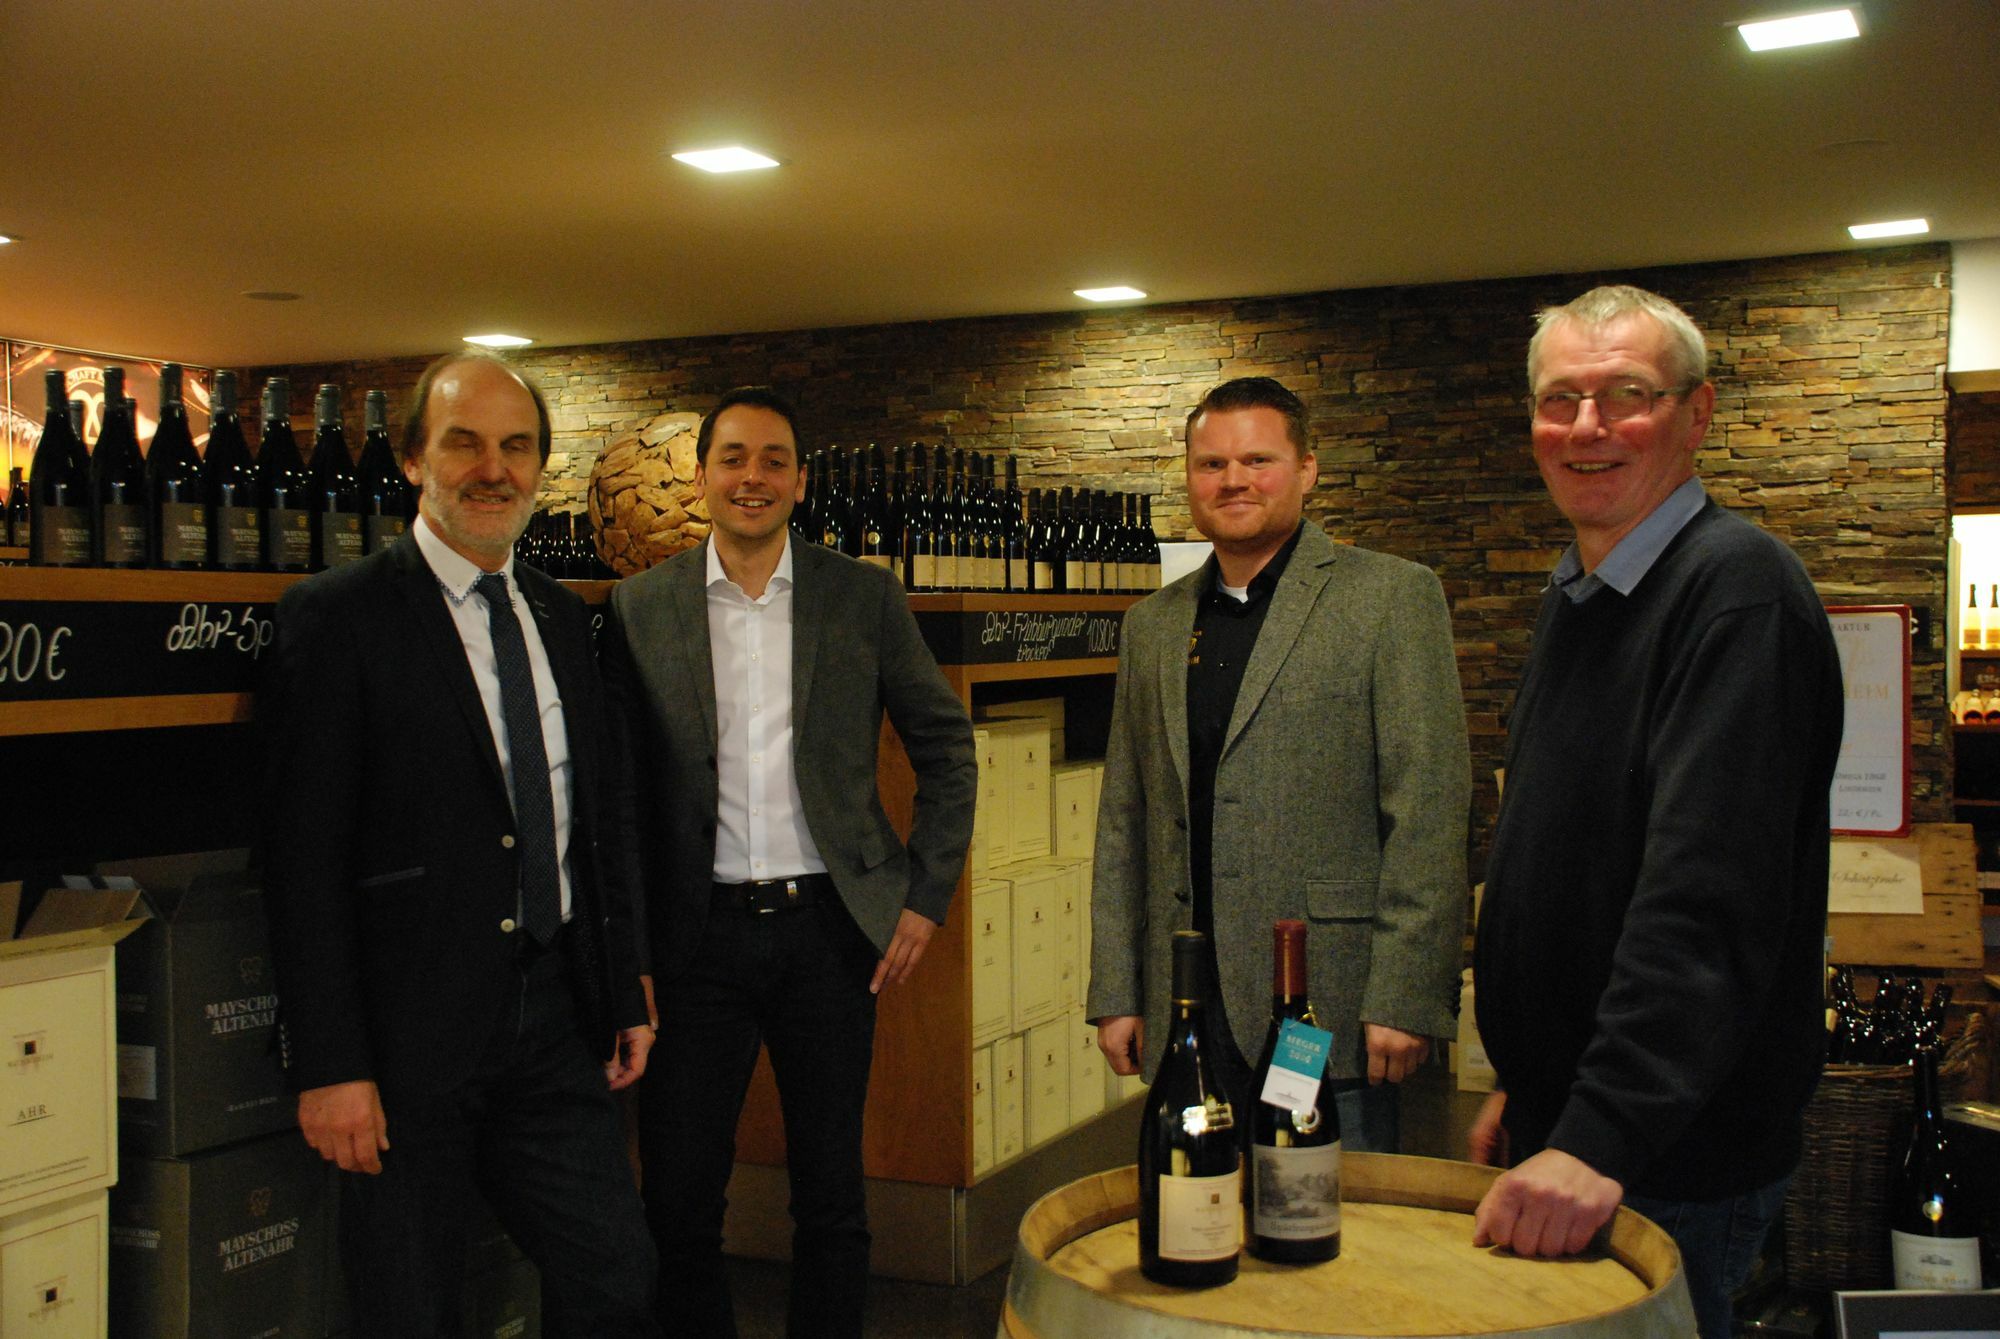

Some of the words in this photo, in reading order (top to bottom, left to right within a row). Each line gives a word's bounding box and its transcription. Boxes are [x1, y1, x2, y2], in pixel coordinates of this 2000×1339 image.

[206, 994, 278, 1019] MAYSCHO
[17, 1104, 48, 1120] AHR
[218, 1217, 301, 1257] MAYSCHOSS
[223, 1235, 296, 1273] ALTENAHR
